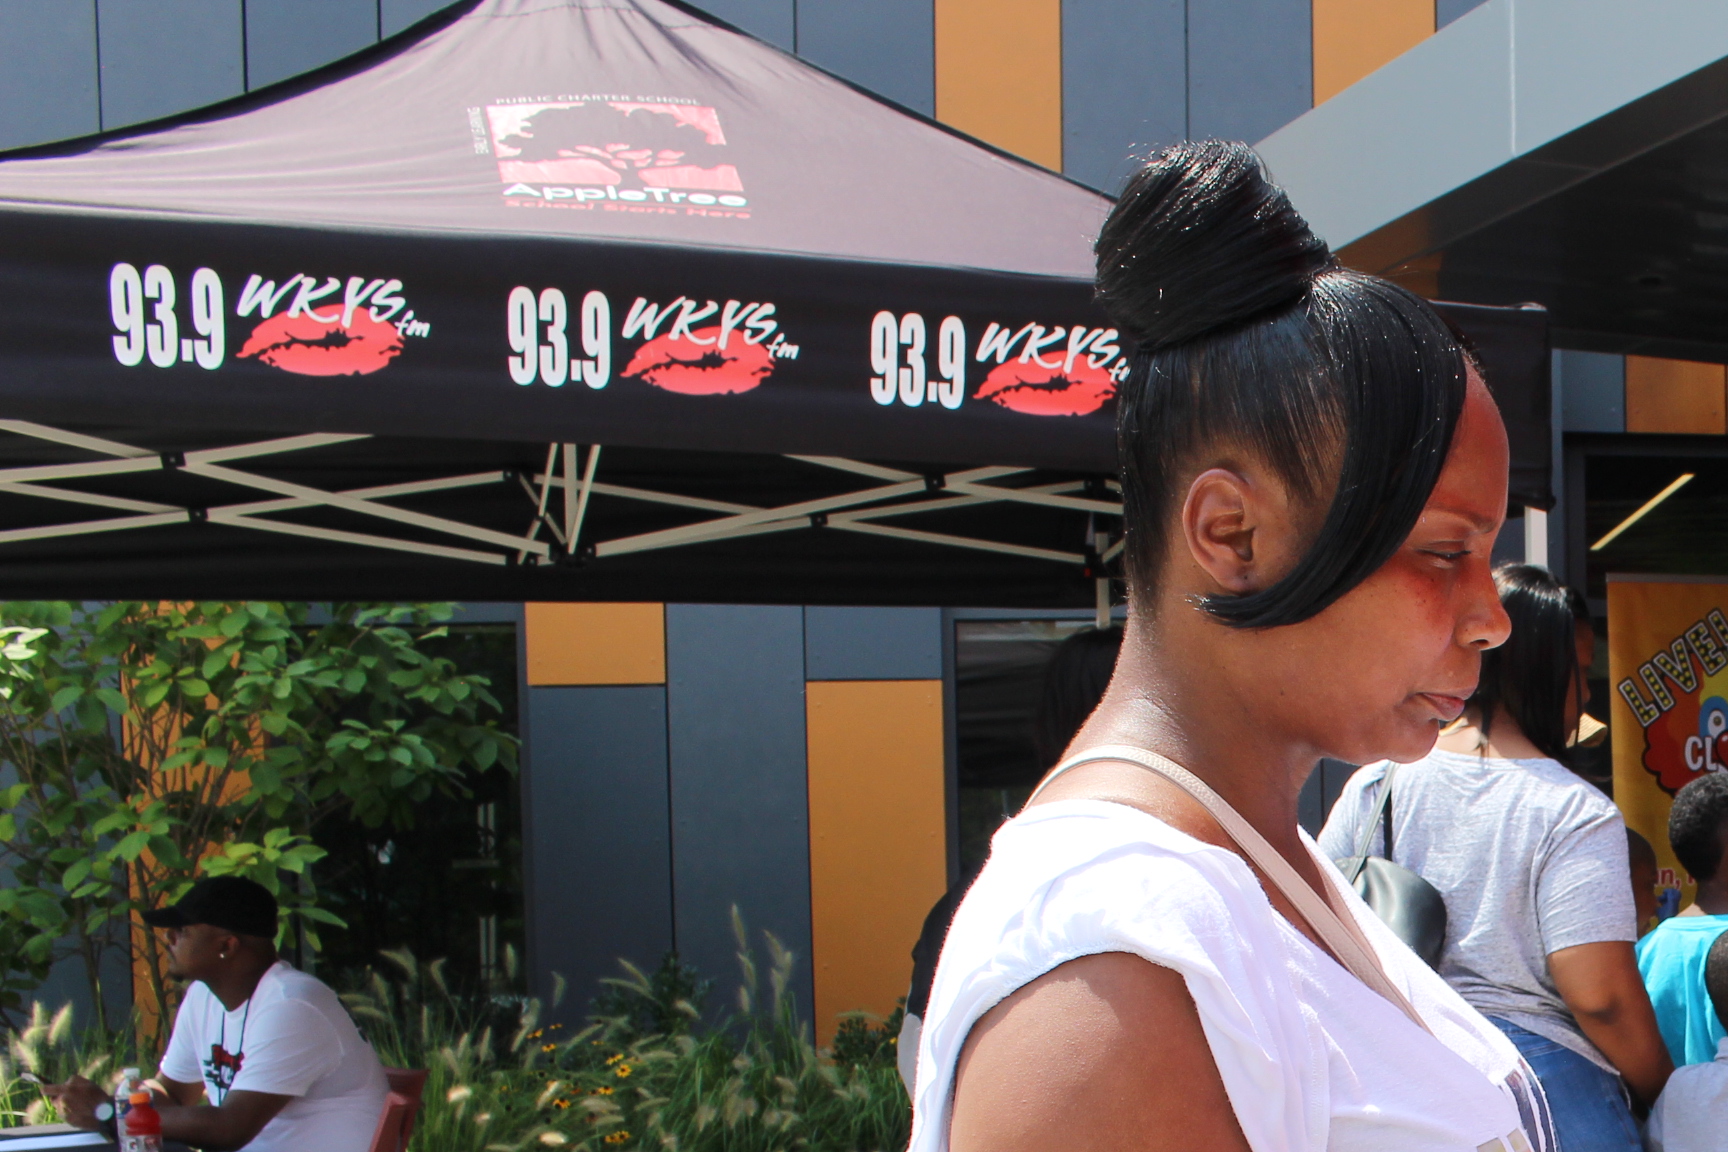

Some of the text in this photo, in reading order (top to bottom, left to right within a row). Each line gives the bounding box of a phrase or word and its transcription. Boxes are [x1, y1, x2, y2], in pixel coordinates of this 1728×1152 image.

[495, 93, 701, 106] PUBLIC CHARTER SCHOOL
[502, 182, 749, 208] AppleTree
[504, 200, 752, 220] School Starts Here
[109, 262, 226, 371] 93.9
[236, 272, 406, 329] WKYS
[507, 285, 612, 390] 93.9
[621, 295, 778, 350] WKYS
[869, 309, 967, 410] 93.9
[975, 320, 1122, 374] WKYS
